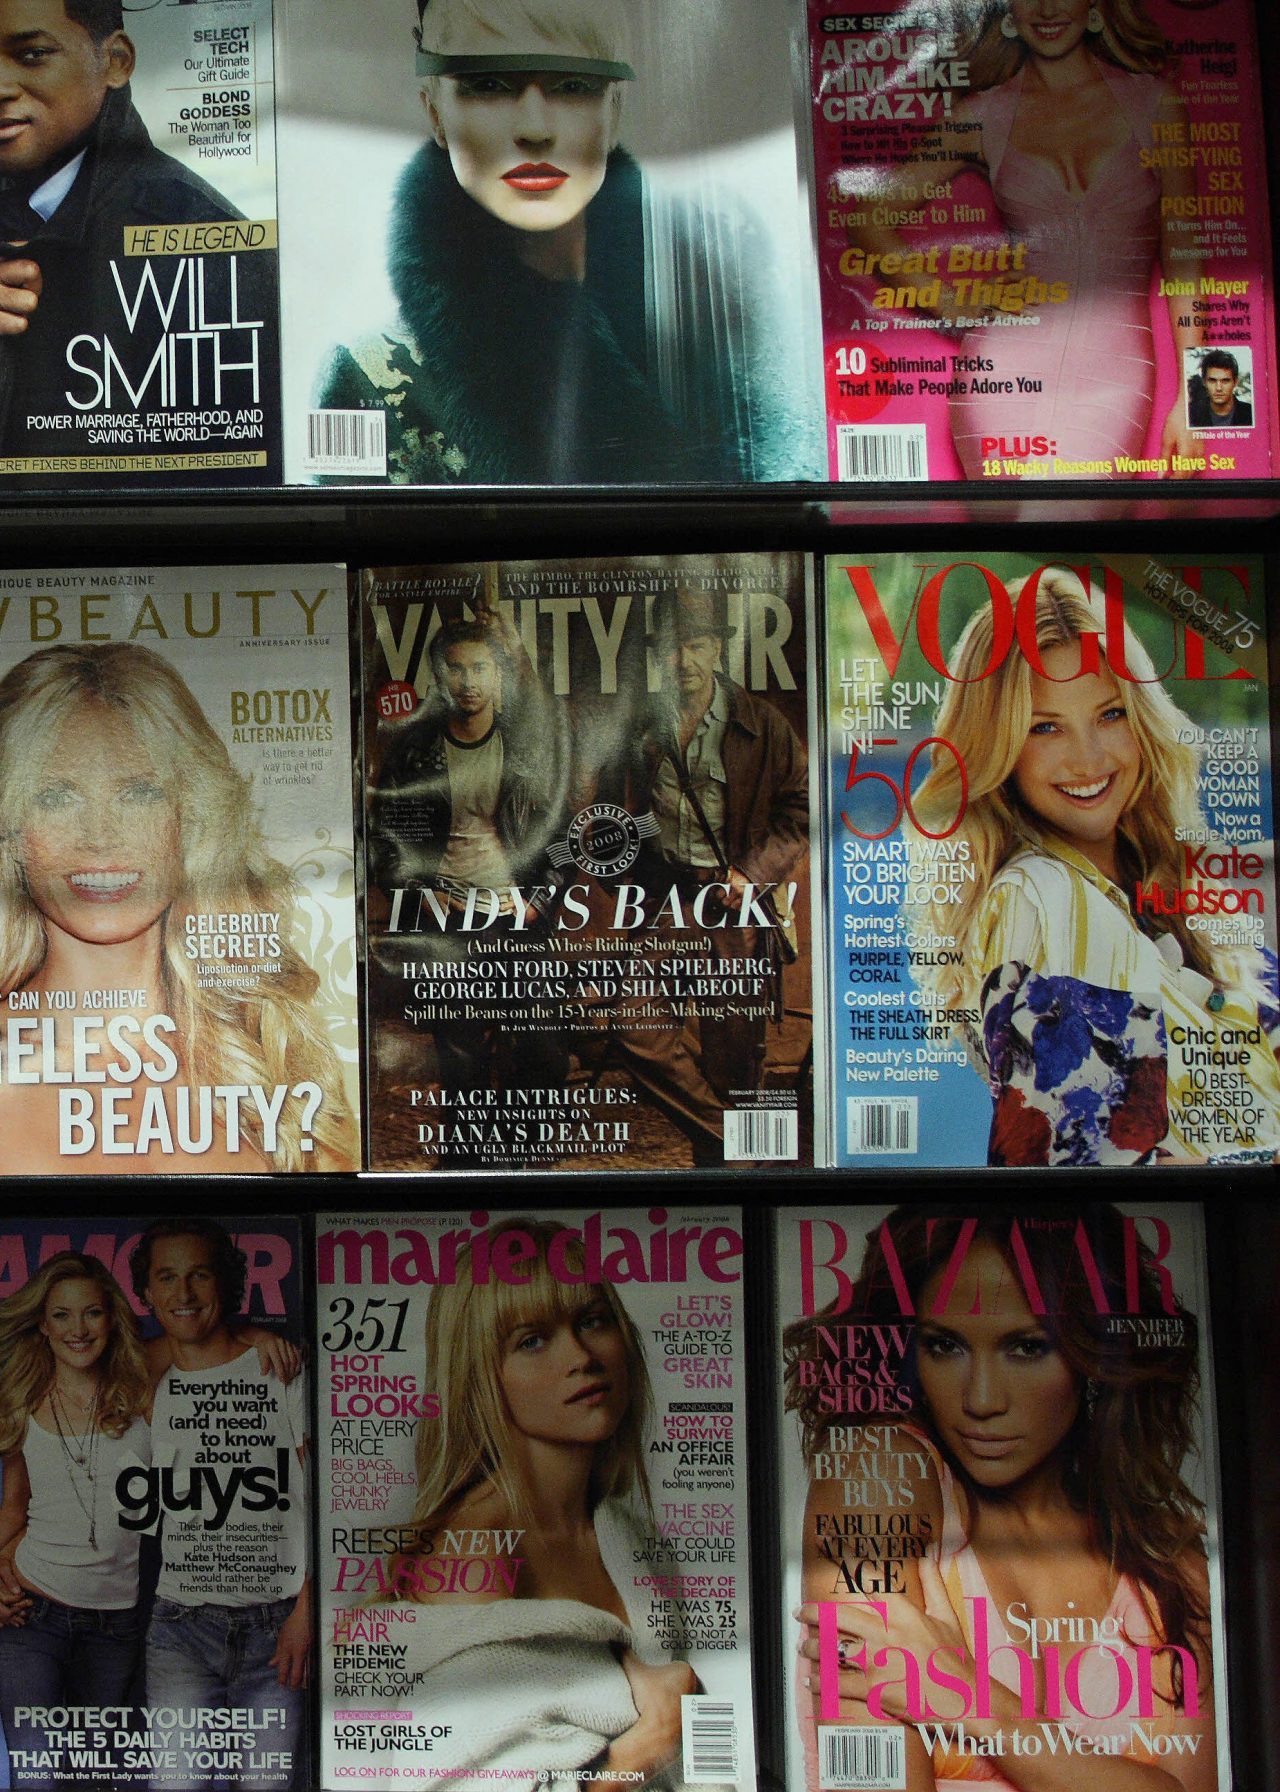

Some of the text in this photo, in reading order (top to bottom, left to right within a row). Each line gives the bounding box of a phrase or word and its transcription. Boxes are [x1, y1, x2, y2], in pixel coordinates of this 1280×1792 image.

[822, 92, 953, 123] CRAZY!
[131, 224, 266, 253] HE IS LEGEND
[109, 255, 264, 334] WILL
[1157, 278, 1249, 297] John Mayer
[65, 330, 259, 411] SMITH
[835, 346, 994, 376] 10 Subliminal Tricks
[32, 459, 78, 471] FIXERS
[81, 457, 125, 470] BEHIND
[128, 456, 152, 470] THE
[154, 456, 186, 468] NEXT
[188, 453, 258, 467] PRESIDENT
[980, 437, 1057, 458] PLUS:
[231, 689, 333, 726] BOTOX
[380, 691, 413, 715] 570
[840, 736, 969, 840] 50
[843, 842, 970, 862] SMART WAYS
[1185, 848, 1264, 879] Kate
[383, 882, 798, 933] INDY'S BACK!
[1135, 881, 1265, 915] Hudson
[185, 913, 281, 935] CELEBRITY
[185, 935, 281, 959] SECRETS
[402, 958, 776, 981] HARRISON FORD, STEVEN SPIELBERG,
[8, 989, 146, 1010] CAN YOU ACHIEVE
[1170, 1026, 1260, 1046] Chic and
[59, 1081, 323, 1155] BEAUTY?
[418, 1122, 630, 1143] DIANA'S DEATH
[317, 1208, 744, 1286] marie claire
[792, 1215, 1180, 1318] BAZAAR
[321, 1296, 411, 1354] 351
[813, 1324, 916, 1361] NEW
[330, 1354, 384, 1373] HOT
[330, 1375, 417, 1393] SPRING
[330, 1394, 441, 1417] LOOKS
[828, 1426, 901, 1453] BEST
[679, 1451, 734, 1466] AFFAIR
[115, 1447, 290, 1532] guys!
[833, 1559, 906, 1595] AGE
[1005, 1601, 1123, 1658] Spring
[796, 1596, 1209, 1722] Fashion
[13, 1706, 287, 1730] PROTECT YOURSELF!
[333, 1724, 452, 1738] LOST GIRLS OF
[333, 1738, 433, 1753] THE JUNGLE
[916, 1722, 1203, 1757] What to Wear Now
